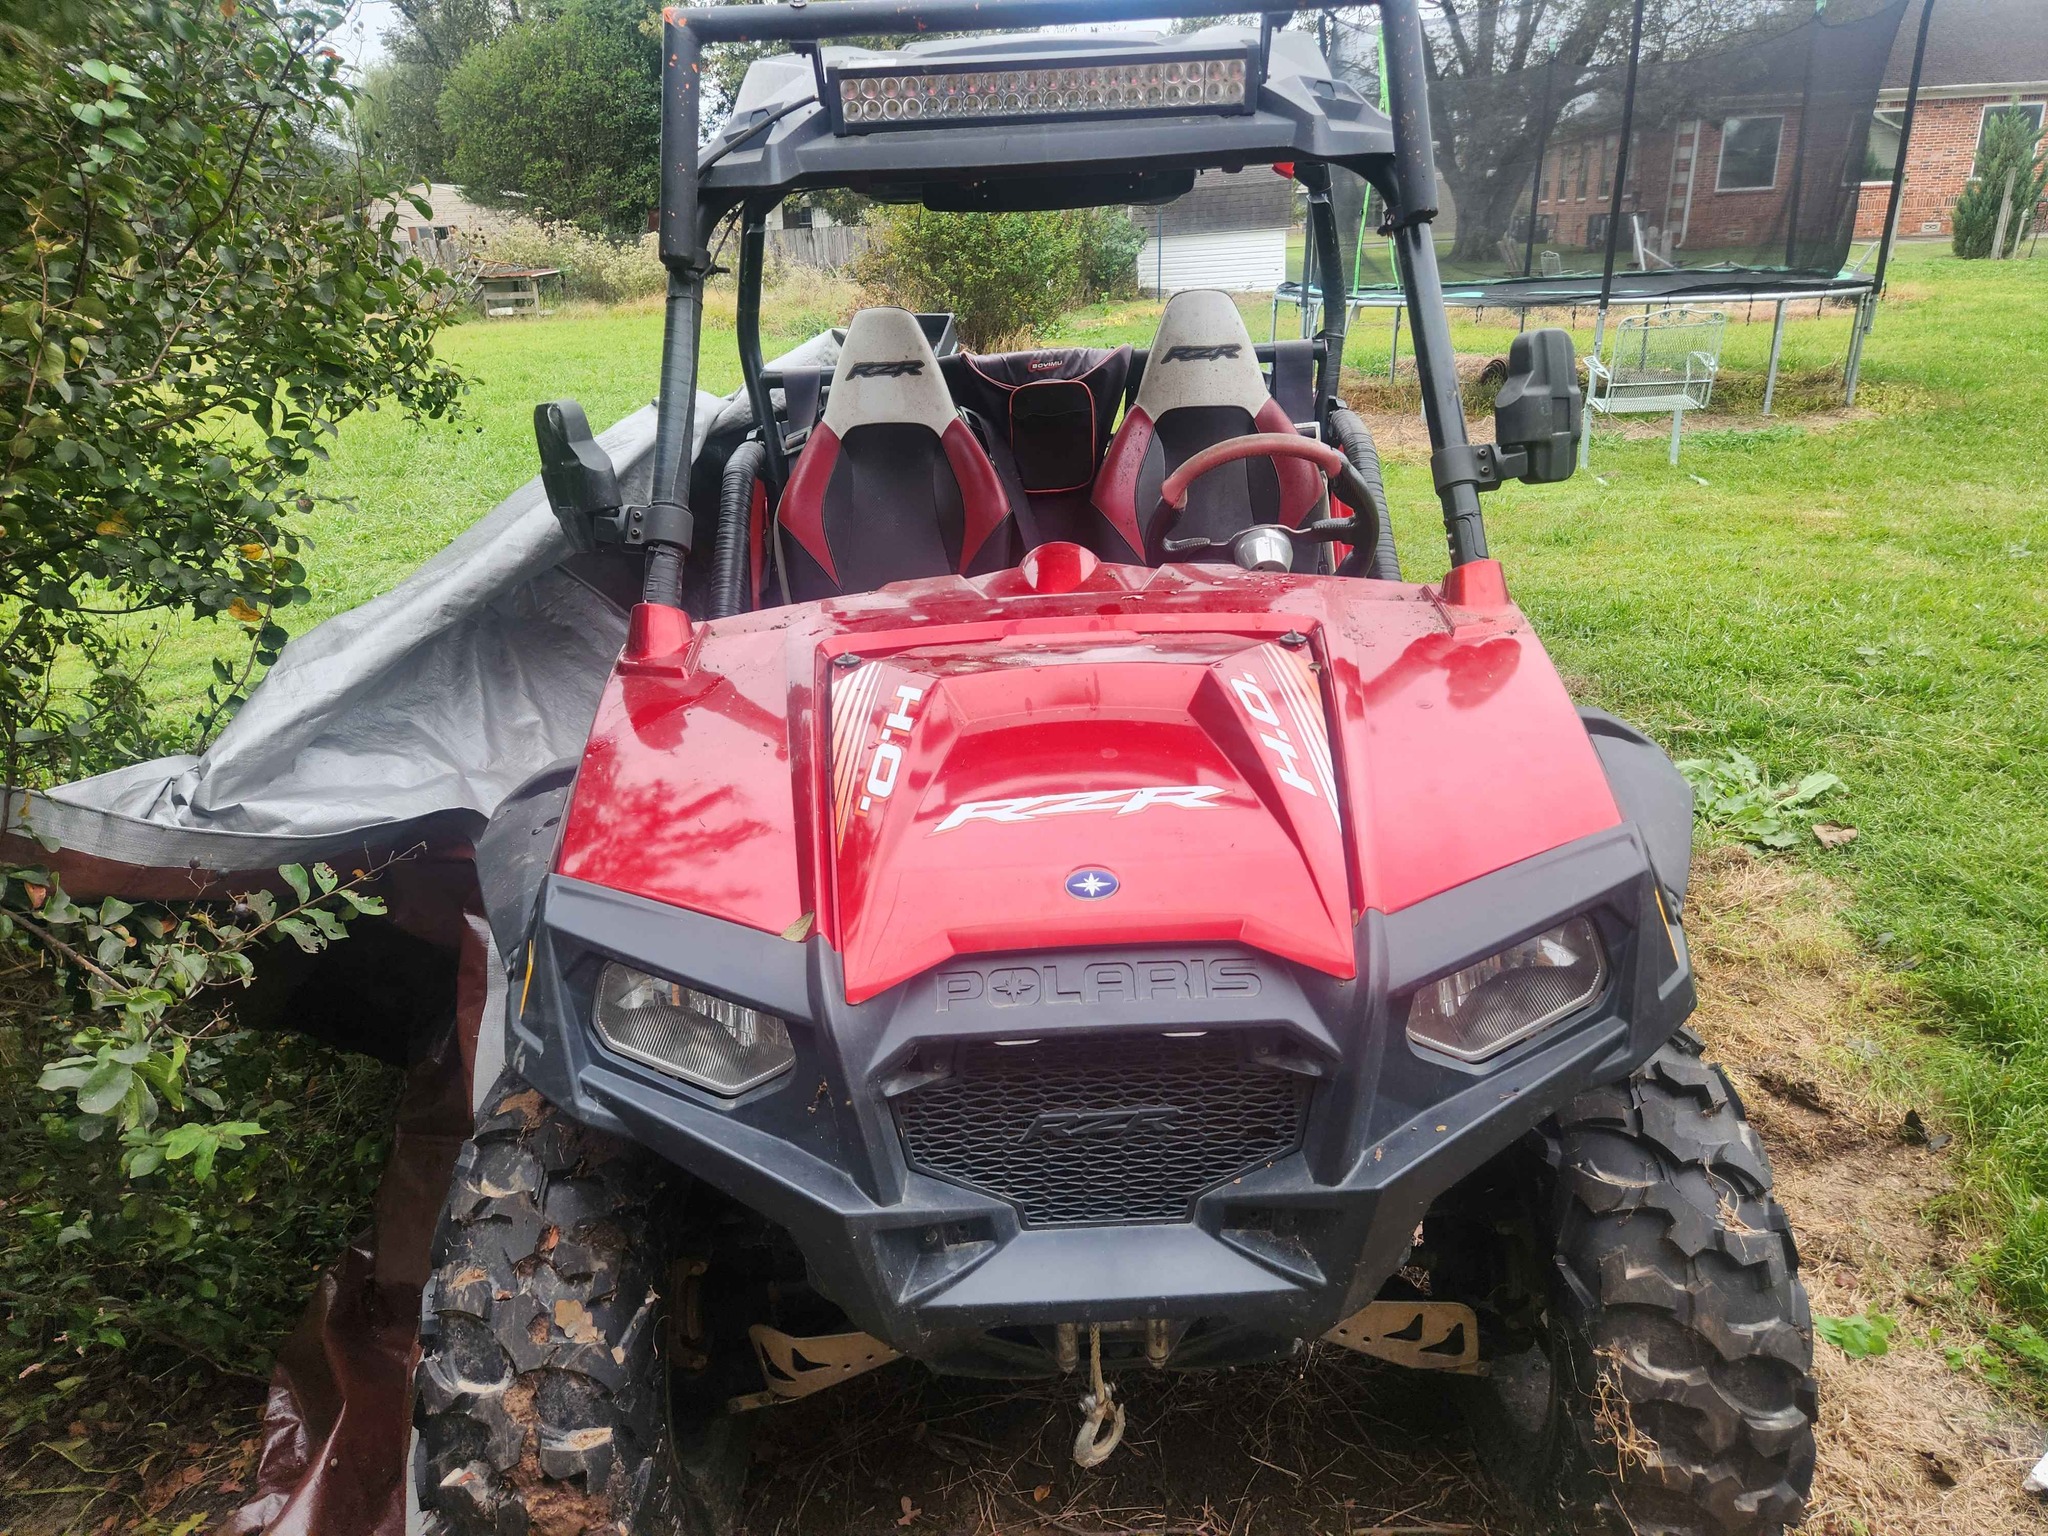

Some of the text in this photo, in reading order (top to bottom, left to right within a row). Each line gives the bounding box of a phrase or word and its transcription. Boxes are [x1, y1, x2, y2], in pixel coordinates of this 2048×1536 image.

[845, 360, 925, 381] RZR
[1032, 360, 1063, 369] BOVIMU
[1160, 343, 1242, 365] RZR
[859, 684, 923, 812] H.O.
[1230, 671, 1318, 797] H.O.
[931, 785, 1228, 833] RZR
[936, 958, 1263, 1013] POLARIS
[1017, 1107, 1182, 1143] RZR
